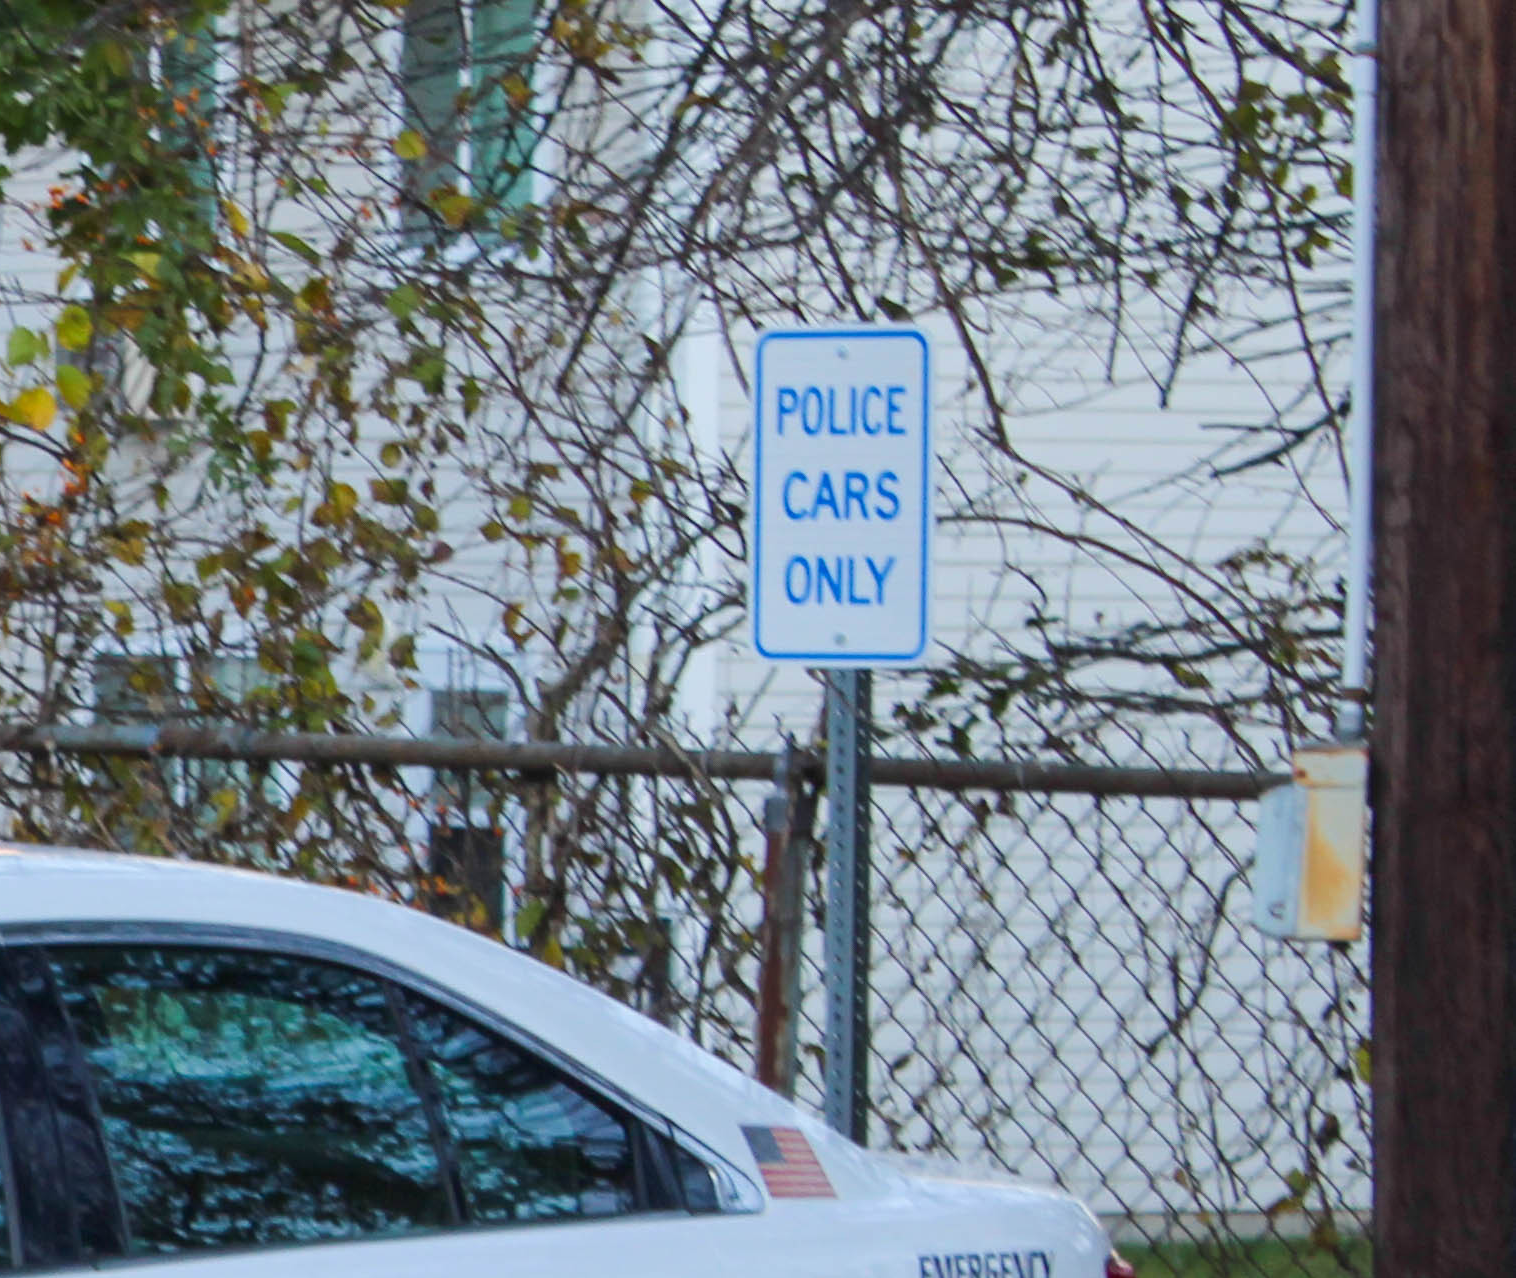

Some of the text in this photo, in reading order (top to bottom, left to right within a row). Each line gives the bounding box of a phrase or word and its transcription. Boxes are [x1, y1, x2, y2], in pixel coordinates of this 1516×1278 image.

[777, 385, 907, 436] POLICE
[782, 470, 901, 521] CARS
[785, 554, 896, 605] ONLY
